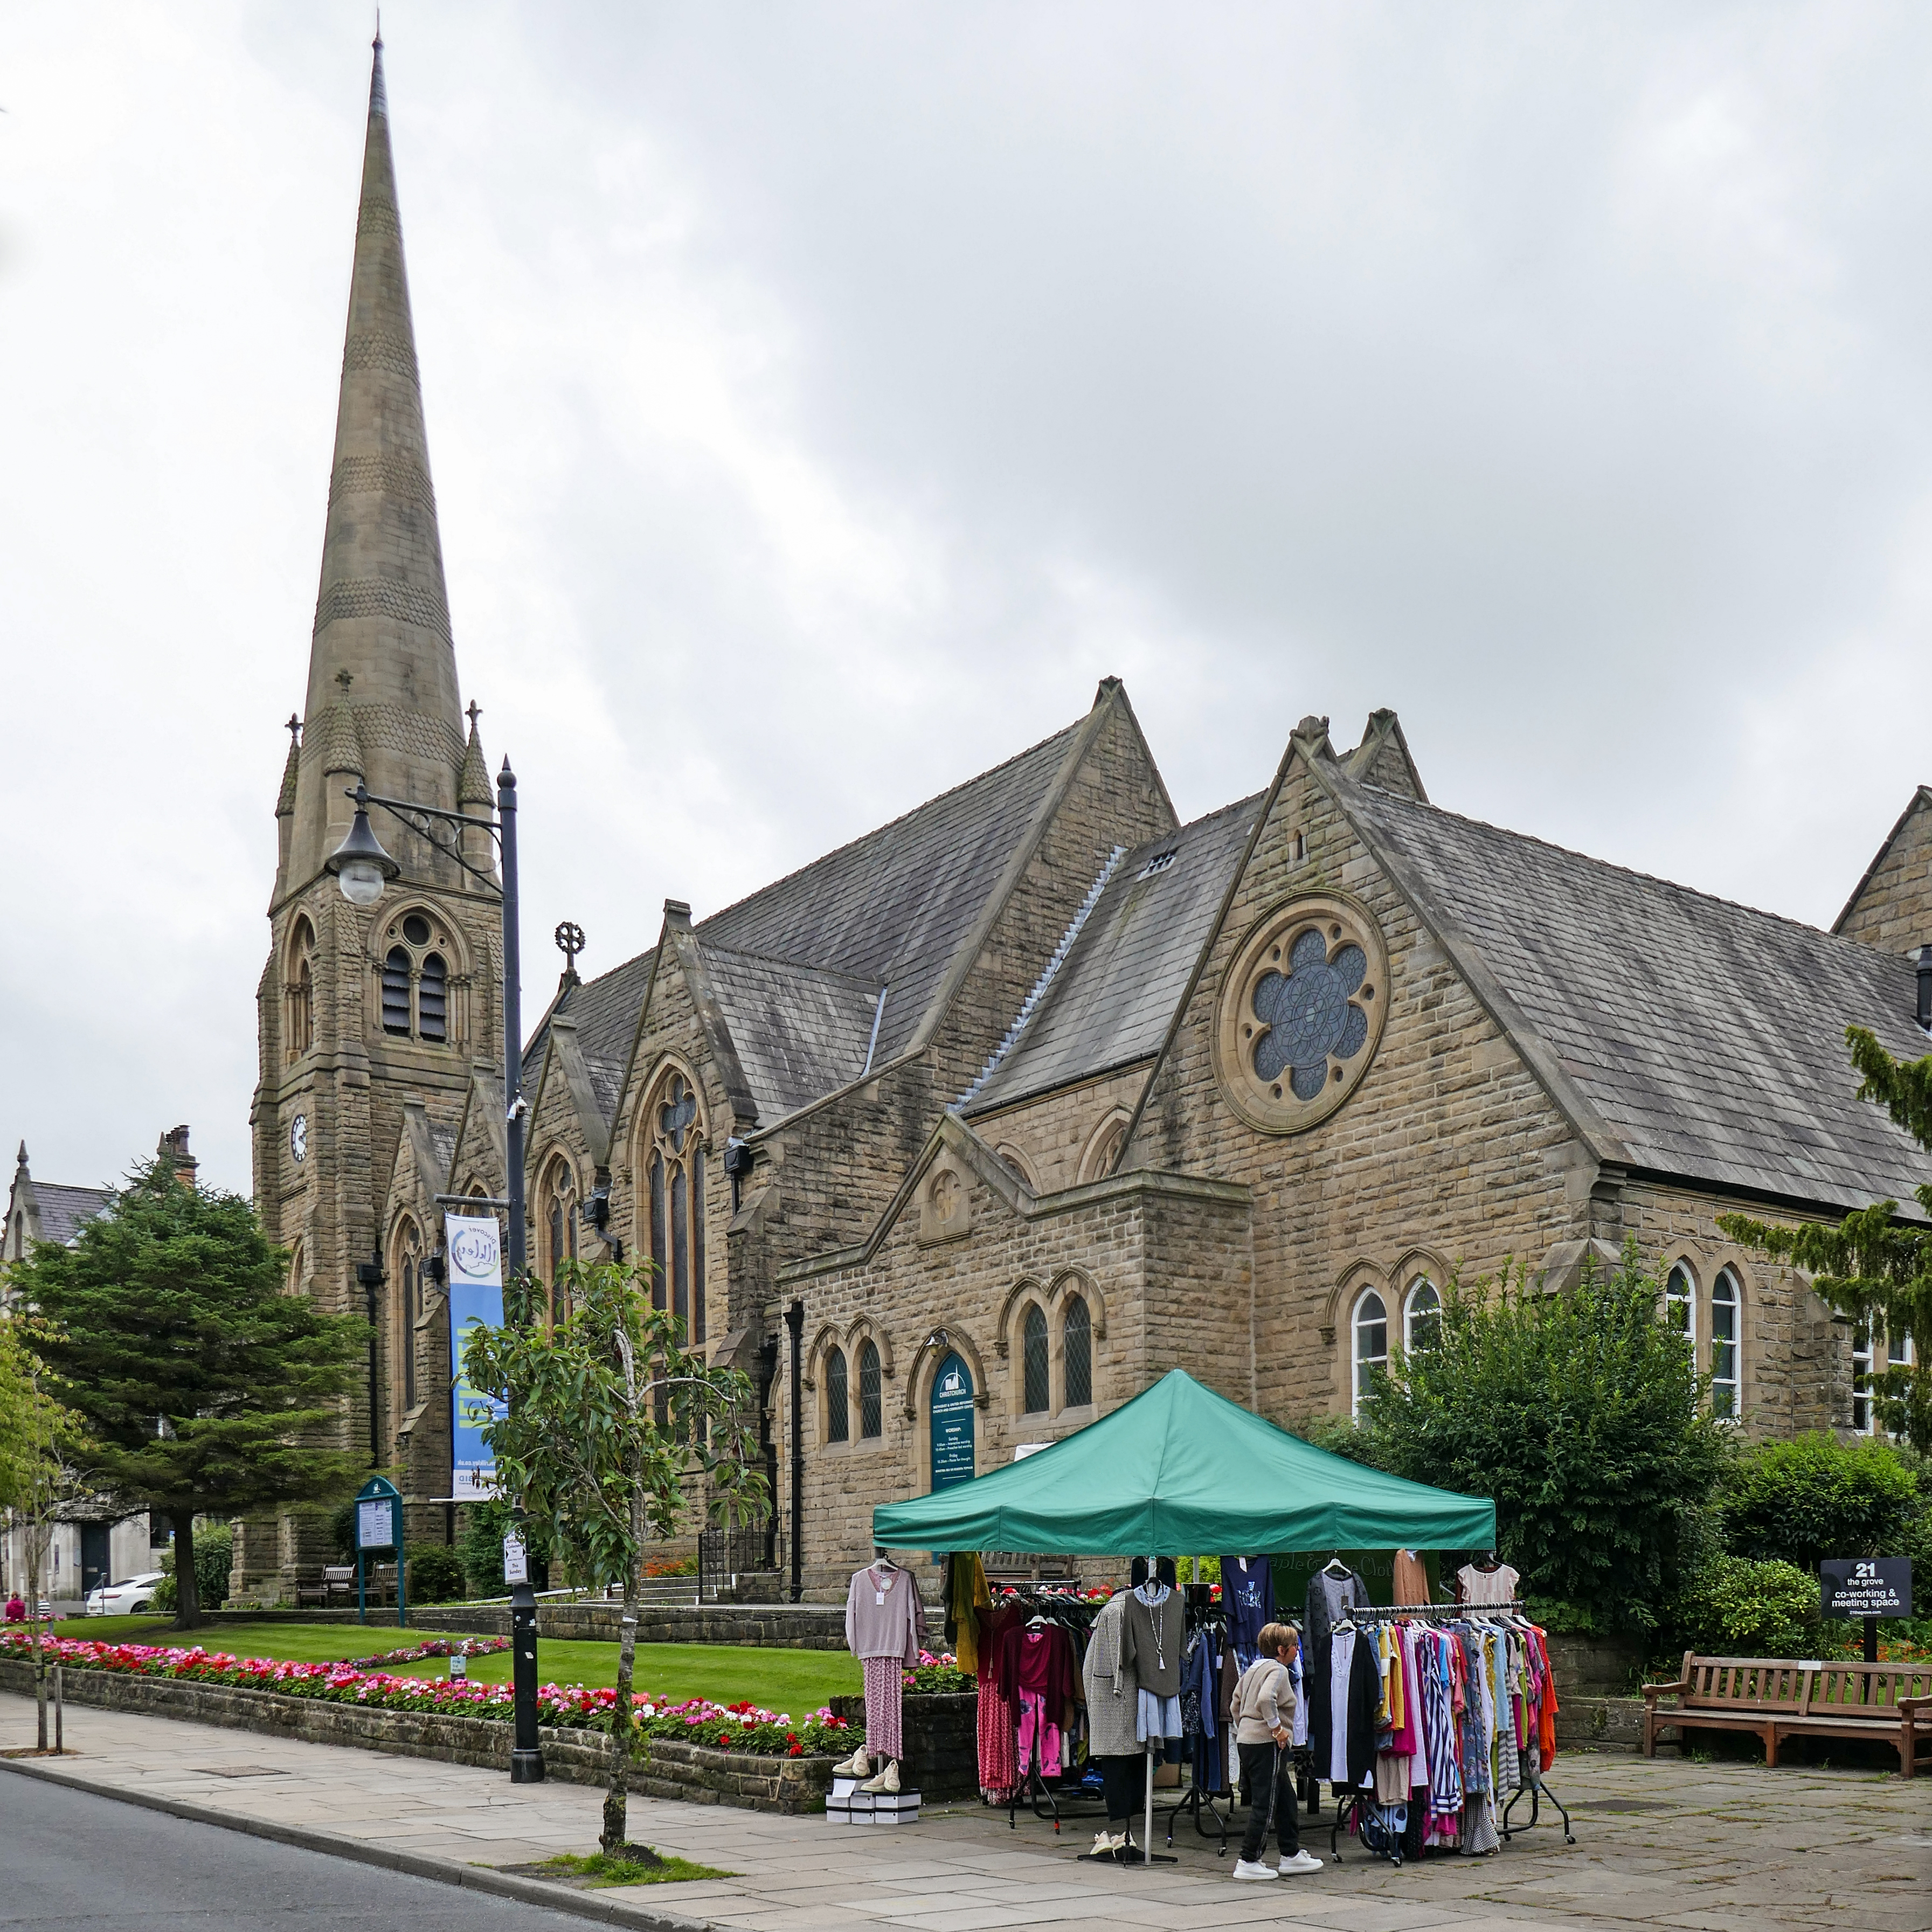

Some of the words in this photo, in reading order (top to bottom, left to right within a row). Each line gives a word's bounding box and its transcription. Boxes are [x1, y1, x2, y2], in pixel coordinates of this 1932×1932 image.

[939, 1388, 966, 1398] CHRISTCHURCH
[1270, 1553, 1304, 1571] aple
[1306, 1553, 1323, 1572] &
[1855, 1562, 1875, 1577] 21
[1861, 1578, 1884, 1587] grove
[1834, 1589, 1886, 1599] co-working
[1888, 1588, 1896, 1597] &
[1832, 1598, 1868, 1609] meeting
[1871, 1598, 1900, 1608] space
